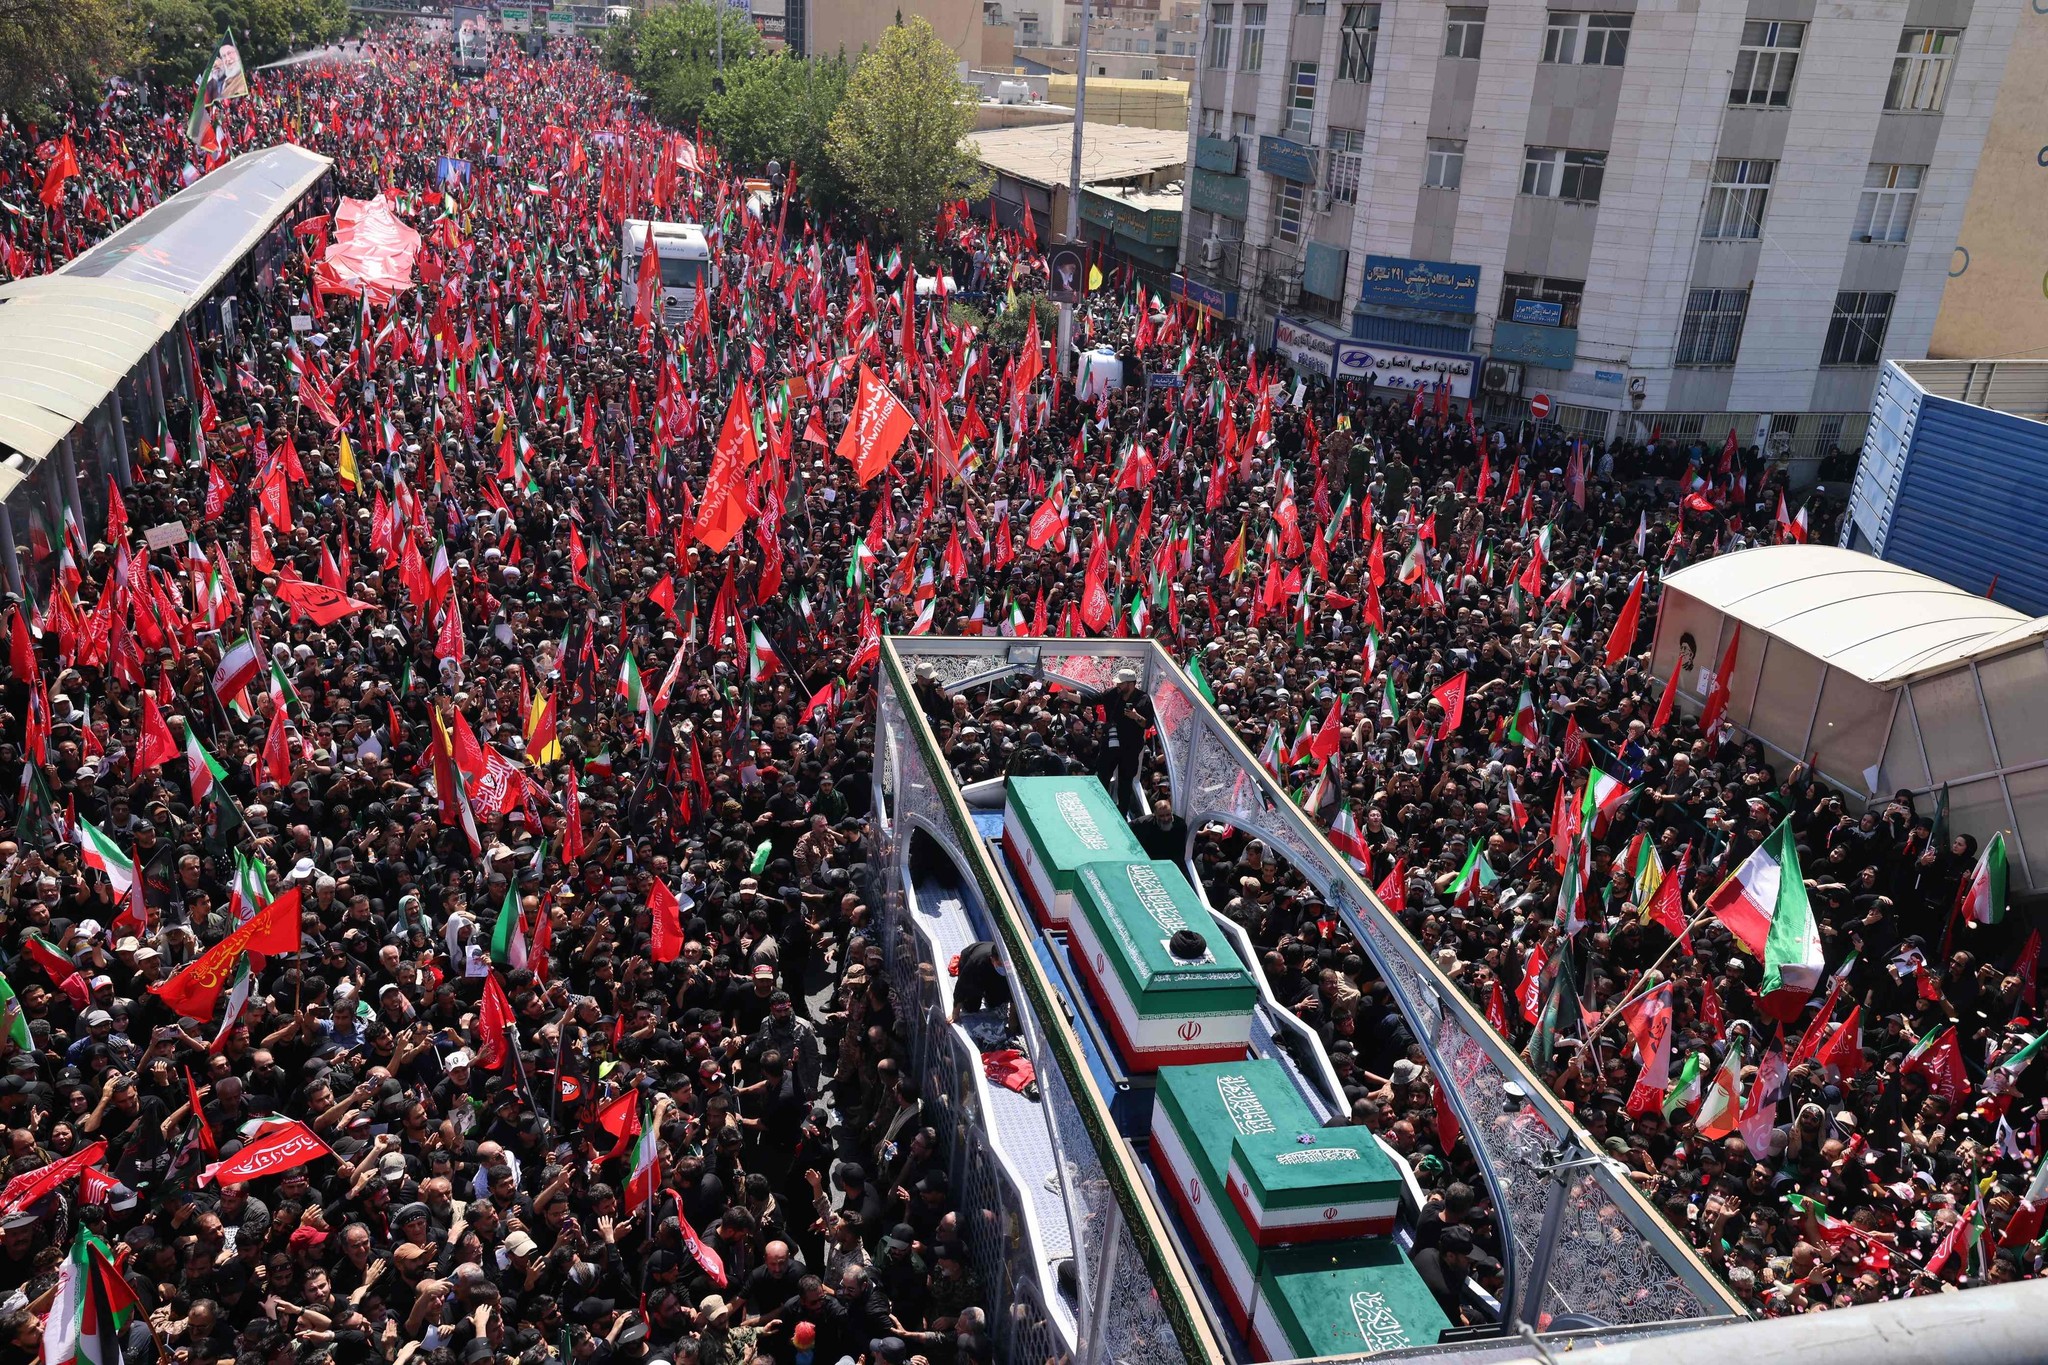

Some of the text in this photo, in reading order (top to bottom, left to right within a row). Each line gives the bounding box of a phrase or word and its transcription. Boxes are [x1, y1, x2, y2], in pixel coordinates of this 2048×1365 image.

[1454, 275, 1475, 289] دفتر
[1375, 355, 1471, 376] قطعات اصلی انصاری
[857, 395, 898, 468] OWN WITH ISRA
[699, 487, 729, 528] DOWN
